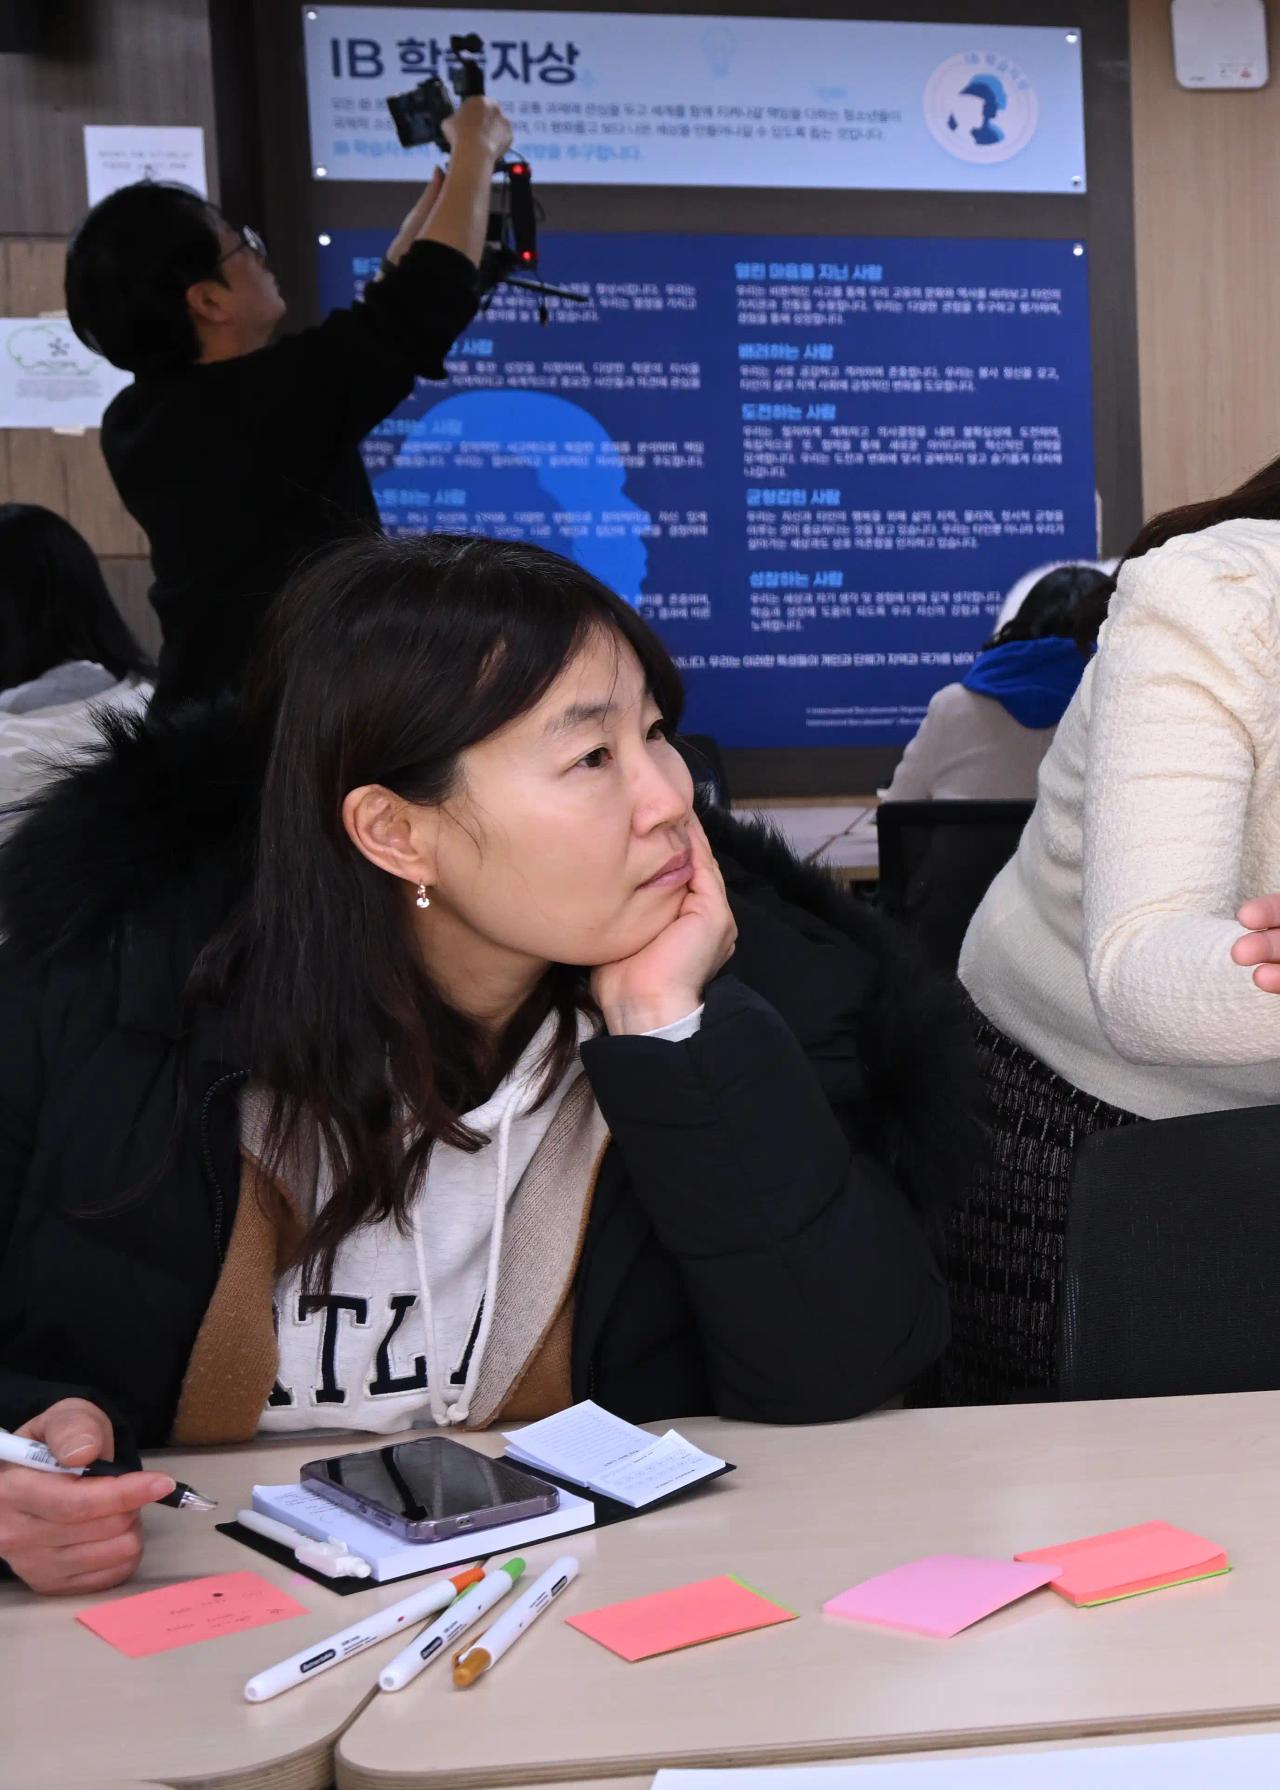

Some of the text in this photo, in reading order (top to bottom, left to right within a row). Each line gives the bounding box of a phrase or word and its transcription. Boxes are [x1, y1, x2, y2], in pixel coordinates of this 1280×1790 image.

[331, 37, 580, 85] IB 학자상
[803, 344, 833, 360] 사람
[806, 404, 836, 421] 사람
[813, 570, 843, 588] 사람
